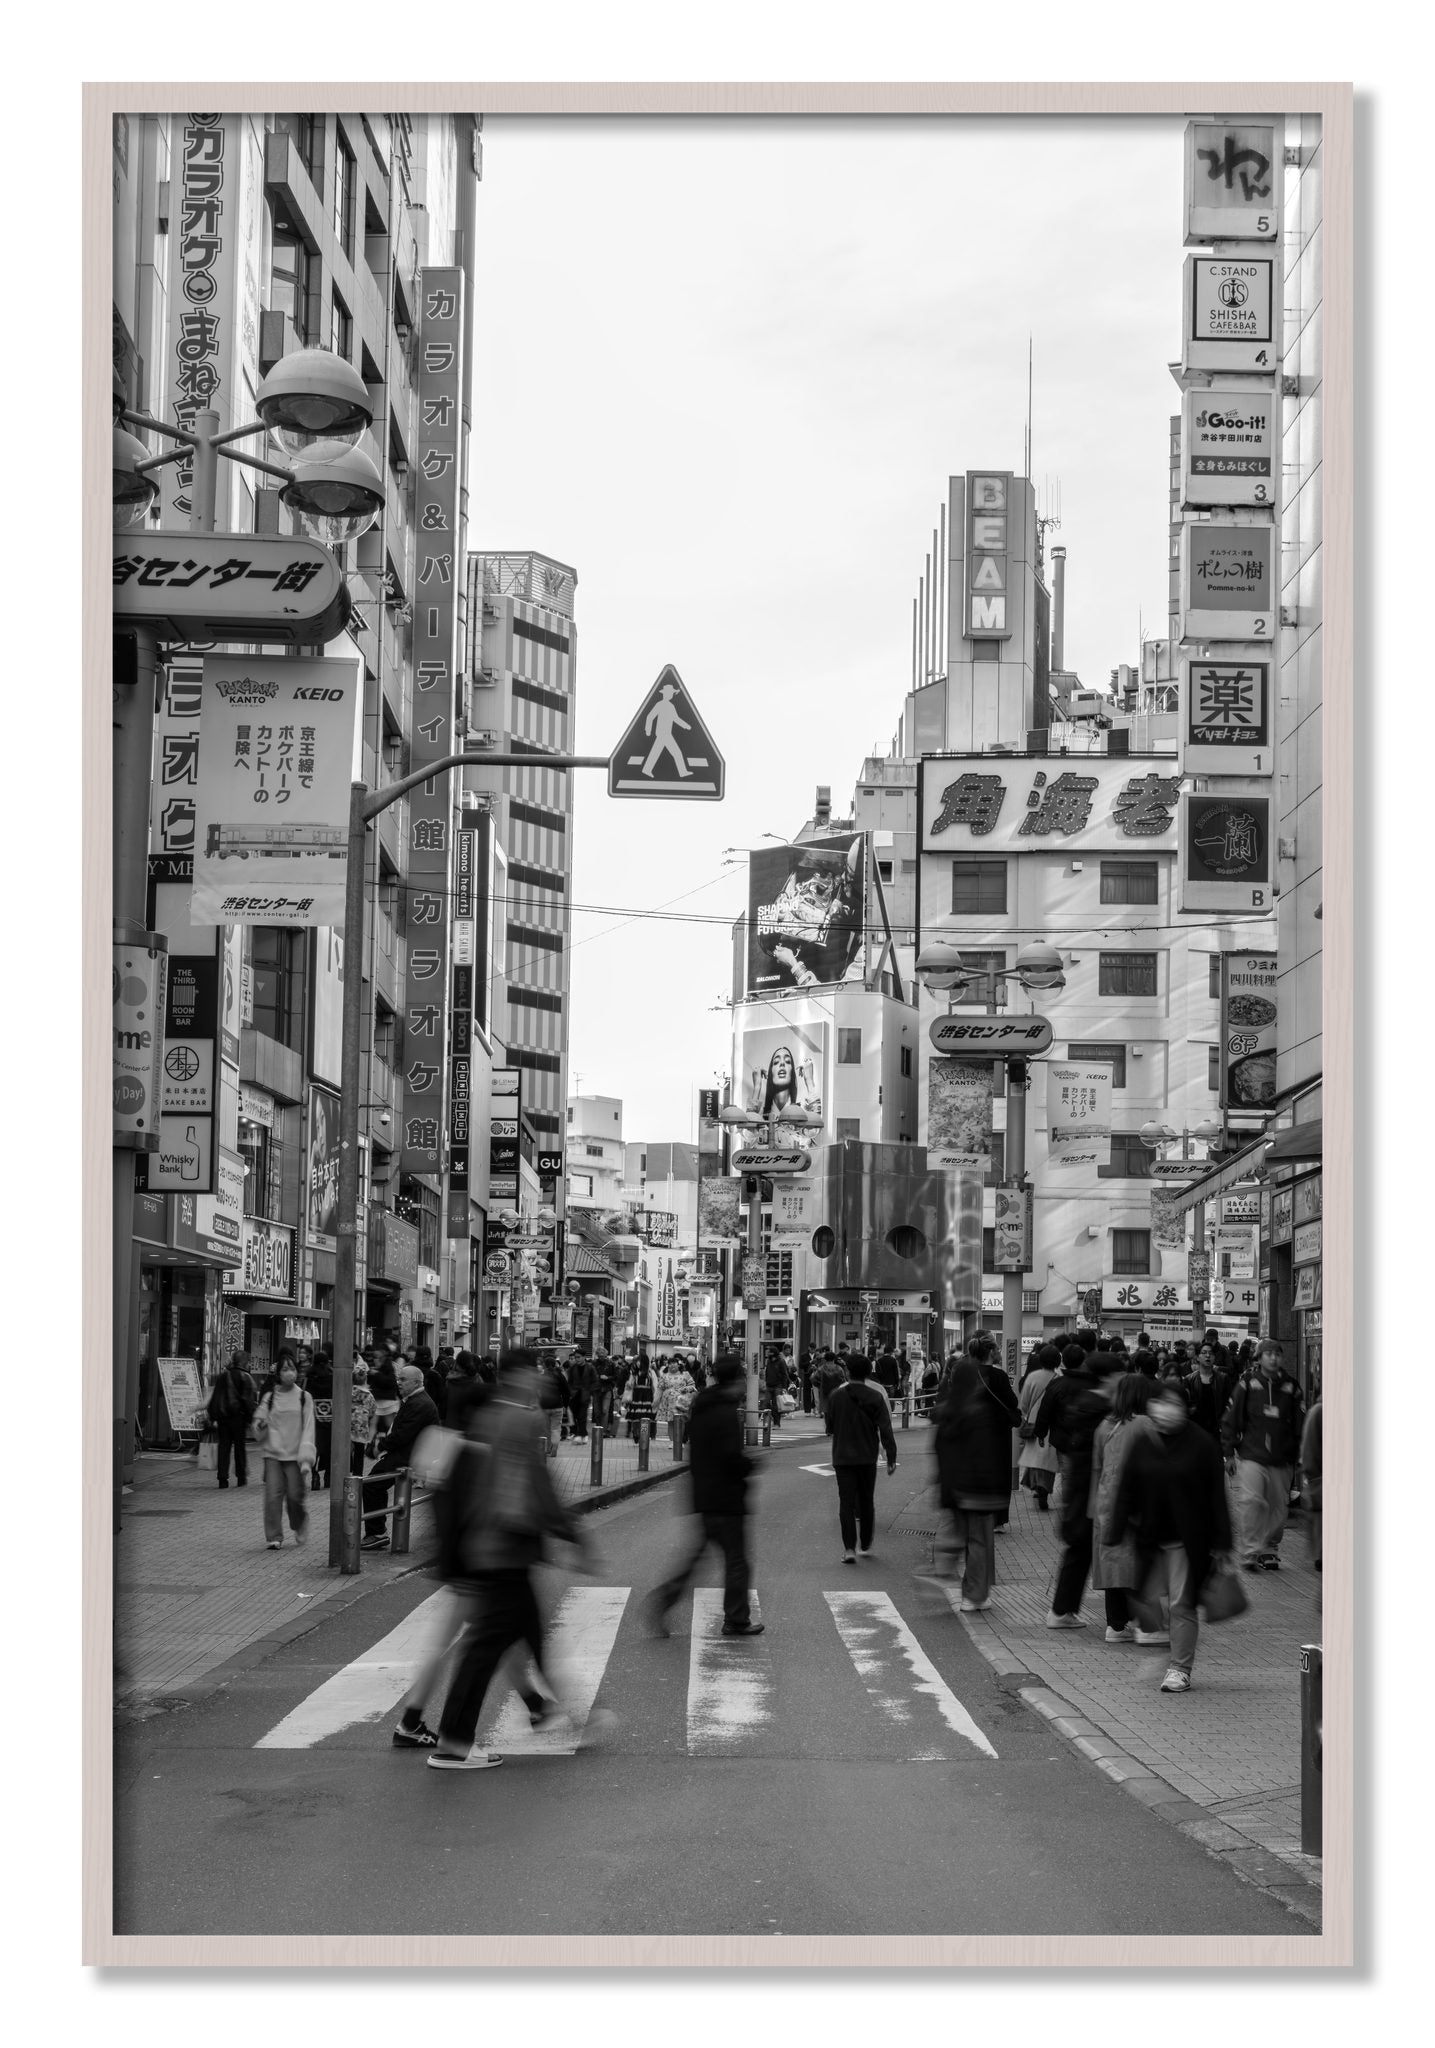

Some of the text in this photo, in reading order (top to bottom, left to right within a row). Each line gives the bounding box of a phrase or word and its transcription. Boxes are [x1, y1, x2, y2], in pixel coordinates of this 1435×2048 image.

[180, 126, 224, 272] カラオケ
[1257, 216, 1270, 232] 5
[1209, 266, 1257, 276] C.STAND
[1209, 309, 1257, 321] SHISHA
[1209, 321, 1257, 331] CAFE&BAR
[1254, 350, 1268, 366] 4
[1208, 411, 1266, 430] Goo-it!
[1200, 433, 1262, 443] 渋谷宇田川町店
[1195, 460, 1267, 473] 全身もみほぐし
[1254, 484, 1267, 500] 3
[972, 476, 1007, 629] BEAM
[1207, 584, 1255, 592] Pomme-no-ki
[1253, 618, 1266, 635] 2
[229, 696, 266, 704] KANTO
[293, 687, 344, 702] KEIO
[1200, 670, 1253, 723] 薬
[1194, 727, 1260, 742] マツモトキヨシ
[234, 725, 251, 770] 冒険へ
[253, 725, 272, 803] カントーの
[275, 725, 294, 804] ポケパーク
[298, 726, 316, 789] 京王線で
[1253, 754, 1262, 770] 1
[930, 773, 1184, 837] 角海老
[1194, 813, 1258, 865] 一蘭
[459, 835, 470, 914] kimono hearts
[220, 897, 314, 911] 渋谷センター街
[1252, 890, 1264, 906] B
[758, 901, 799, 916] SHAPING
[173, 976, 196, 984] THIRD
[177, 969, 193, 977] THE
[172, 1006, 195, 1014] ROOM
[176, 1018, 191, 1026] BAR
[405, 894, 443, 1151] カラオケ館
[937, 1025, 1046, 1039] 渋谷センター街
[1228, 1034, 1259, 1055] 6F
[503, 1127, 516, 1136] UP
[159, 1154, 195, 1166] Whisky
[540, 1158, 561, 1170] GU
[735, 1154, 802, 1165] 渋谷センター街
[159, 1165, 181, 1173] Bank
[1117, 1283, 1179, 1307] 兆楽
[664, 1282, 675, 1327] BEER
[661, 1328, 676, 1337] HALL
